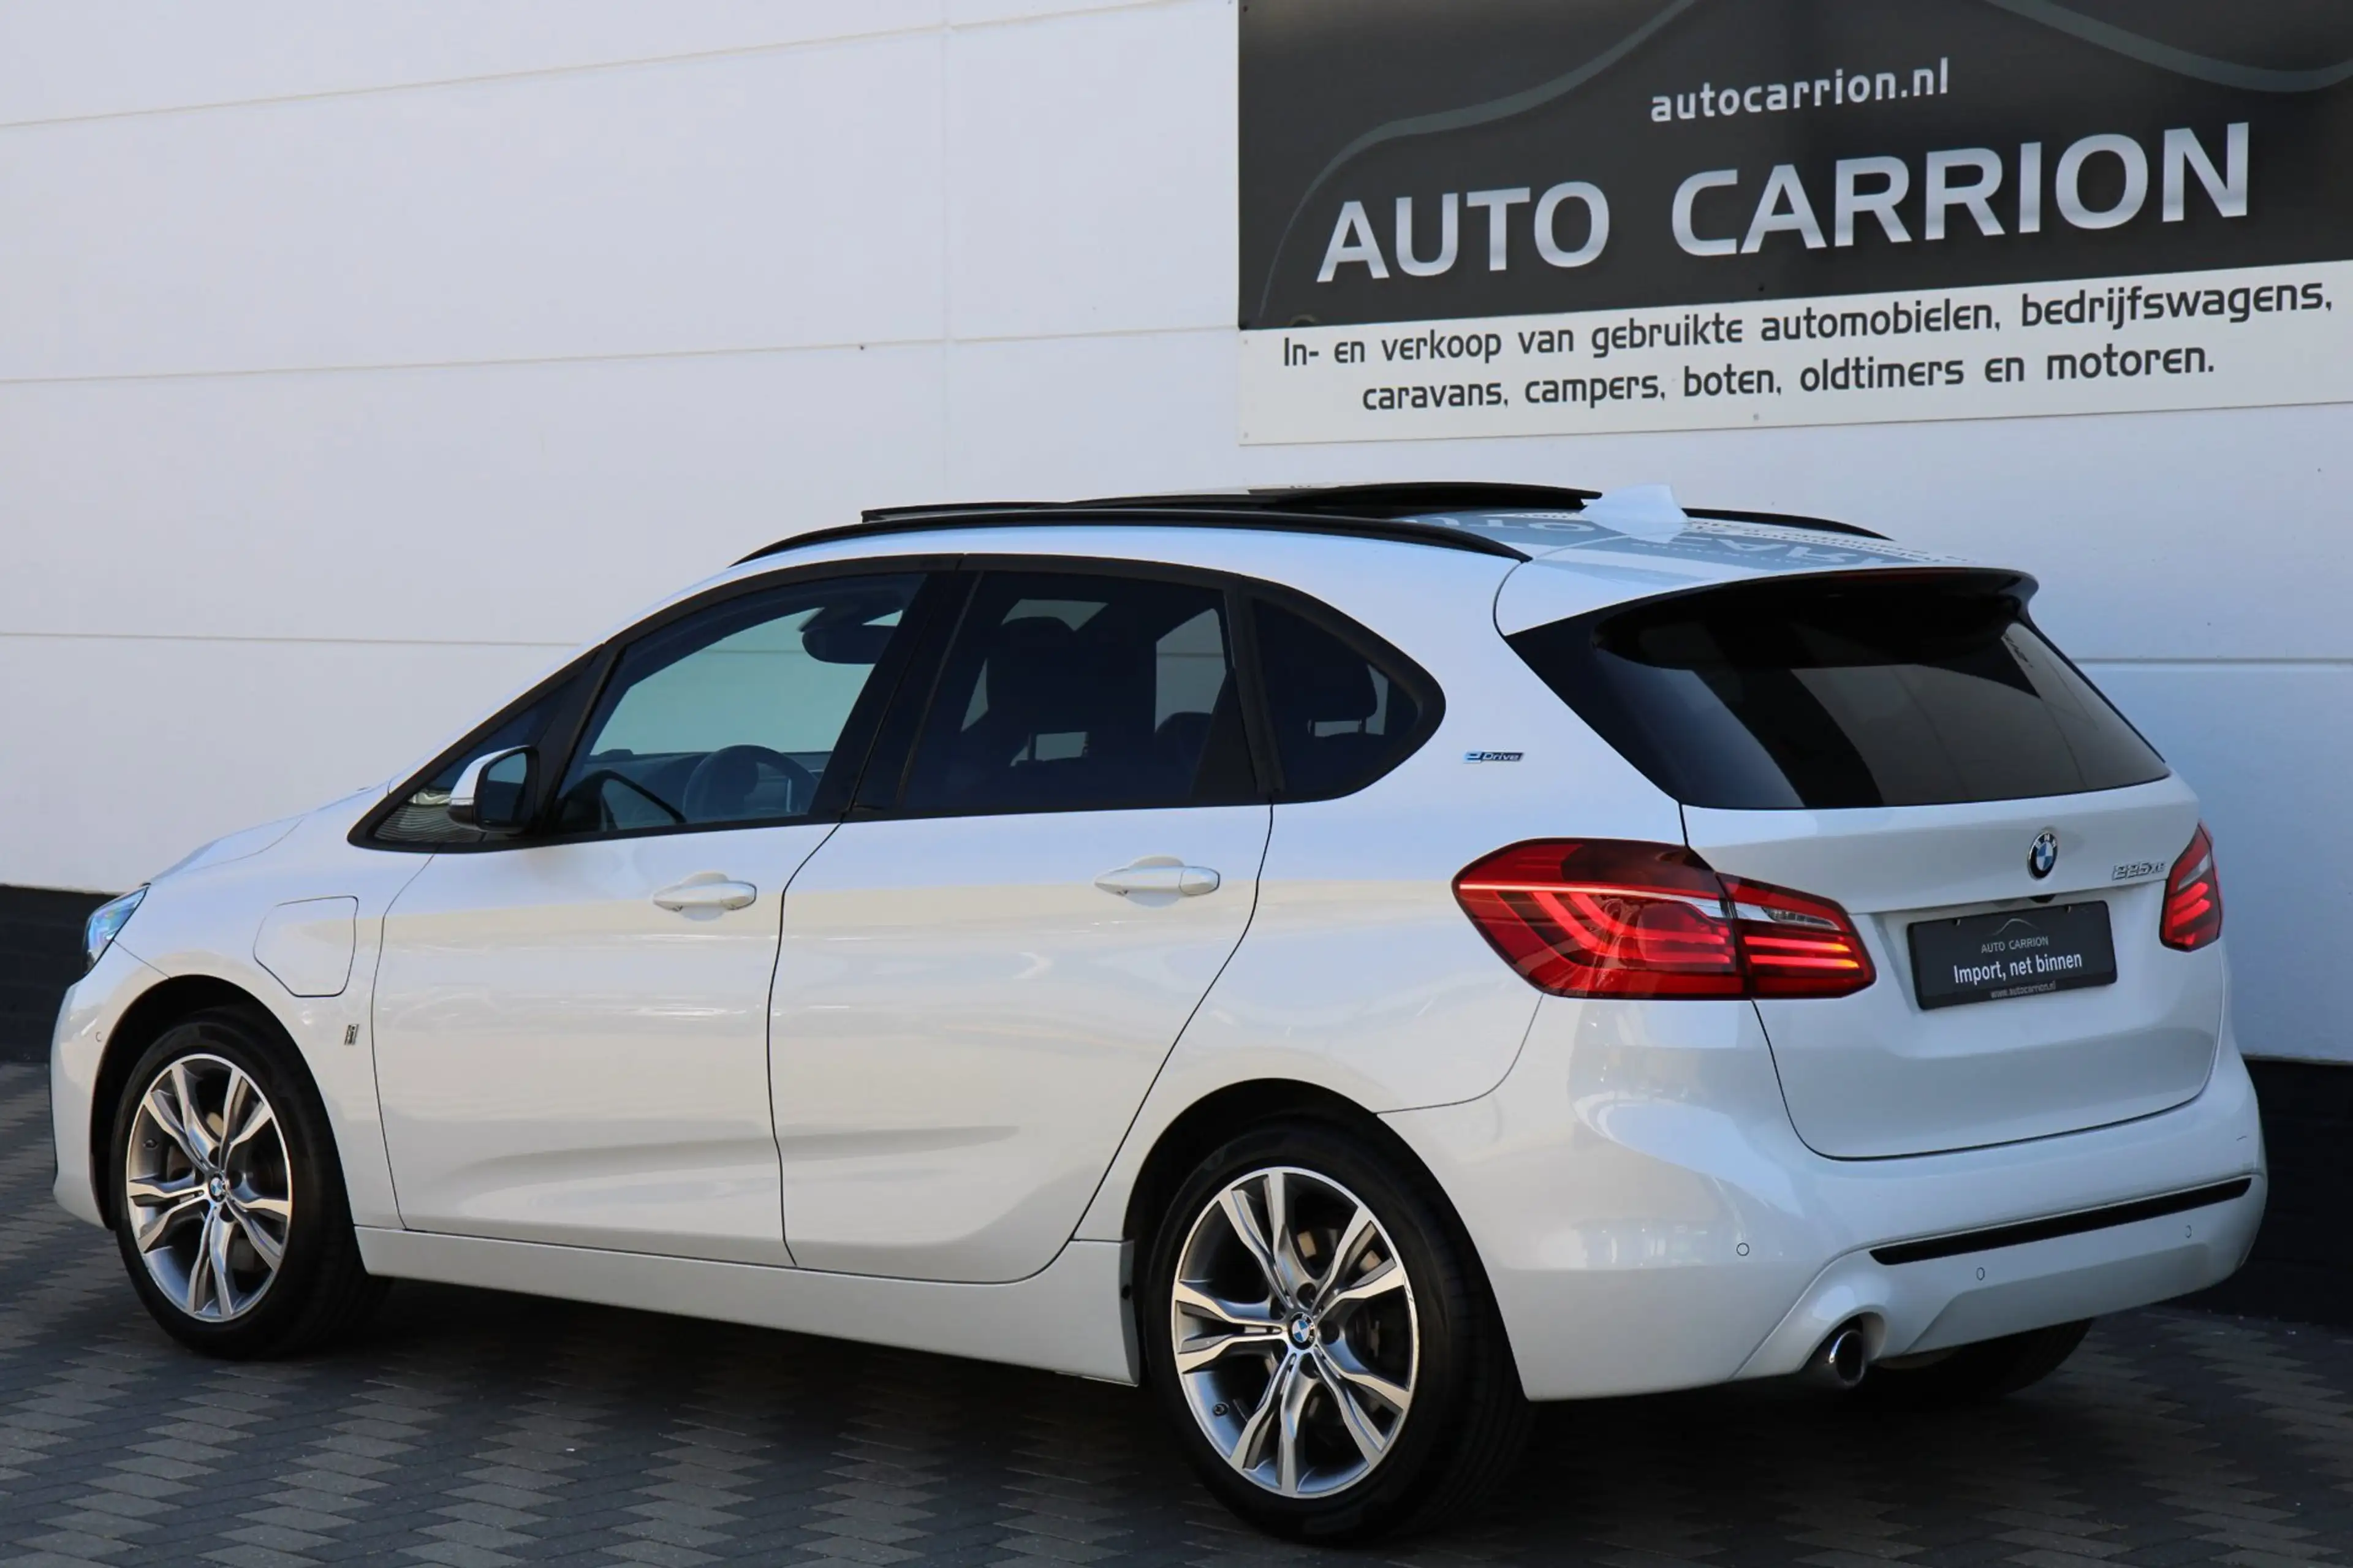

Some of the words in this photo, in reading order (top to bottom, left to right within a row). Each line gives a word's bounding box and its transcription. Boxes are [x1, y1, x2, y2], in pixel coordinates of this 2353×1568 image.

[1651, 57, 1949, 122] autocarrion.nl
[1316, 181, 1610, 282] AUTO
[1672, 123, 2248, 256] CARRION
[1284, 337, 1319, 366] In-
[1333, 341, 1365, 363] en
[1381, 329, 1501, 364] verkoop
[1518, 329, 1574, 354] van
[1591, 312, 1743, 358] gebruikte
[1761, 298, 2000, 341] automobielen,
[2021, 282, 2332, 330] bedrijfswagens,
[1362, 382, 1509, 411] caravans,
[1525, 375, 1665, 409] campers,
[1684, 363, 1782, 397] boten,
[1800, 356, 1965, 392] oldtimers
[1985, 357, 2025, 383] en
[2047, 343, 2215, 381] motoren.
[1953, 961, 2006, 985] Import,
[2009, 956, 2033, 976] net
[2035, 953, 2082, 973] binnen
[1981, 941, 2006, 953] AUTO
[2009, 936, 2049, 950] CARRION
